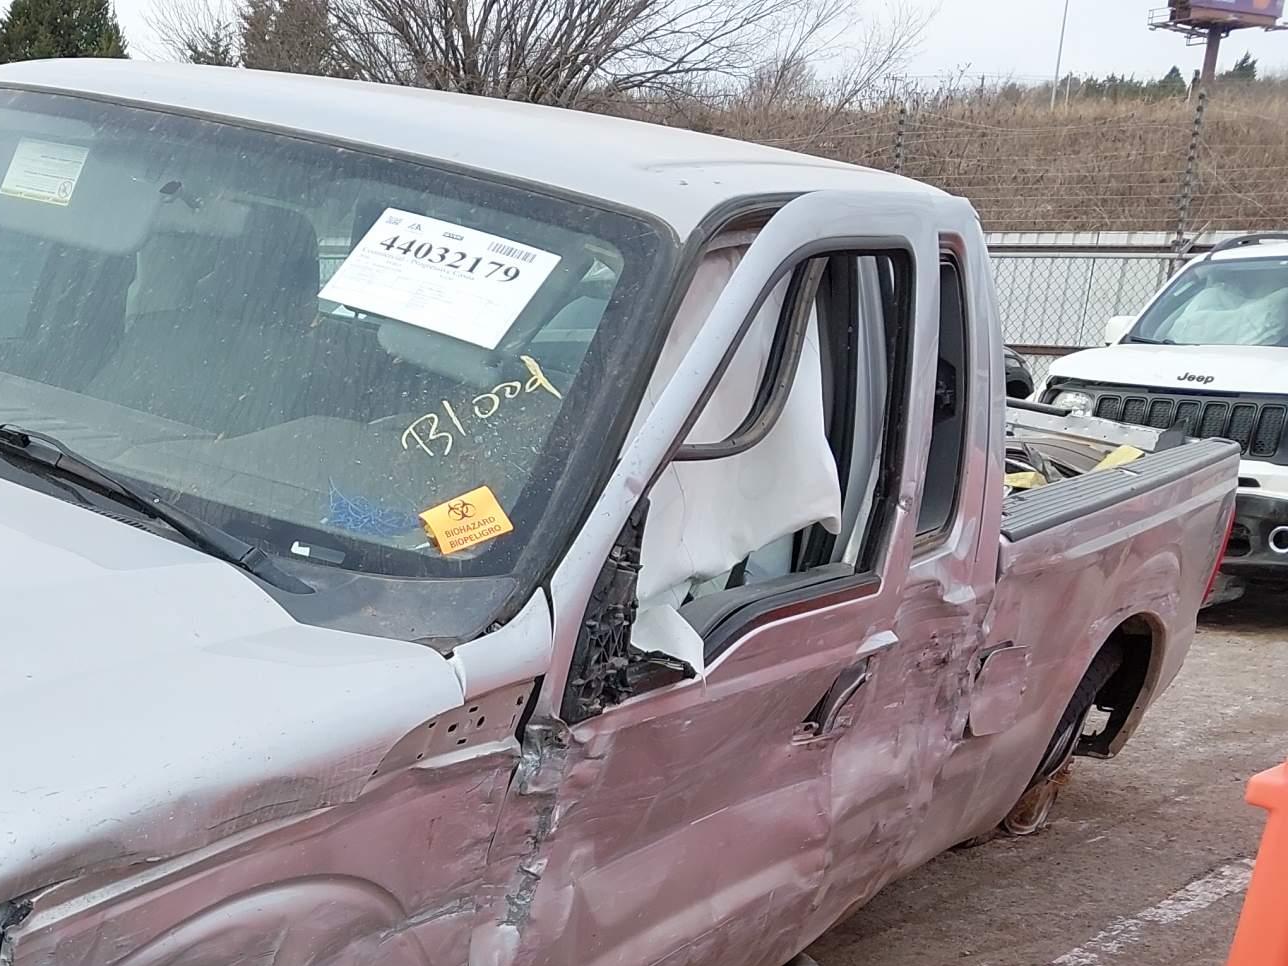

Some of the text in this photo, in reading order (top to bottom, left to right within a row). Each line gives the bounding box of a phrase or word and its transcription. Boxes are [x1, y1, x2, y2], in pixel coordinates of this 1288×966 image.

[379, 235, 521, 283] 44032179
[1176, 372, 1215, 385] Jeep
[401, 354, 563, 457] Blood
[444, 516, 497, 539] BIOHAZARD
[449, 524, 503, 550] BIOPELIGRO
